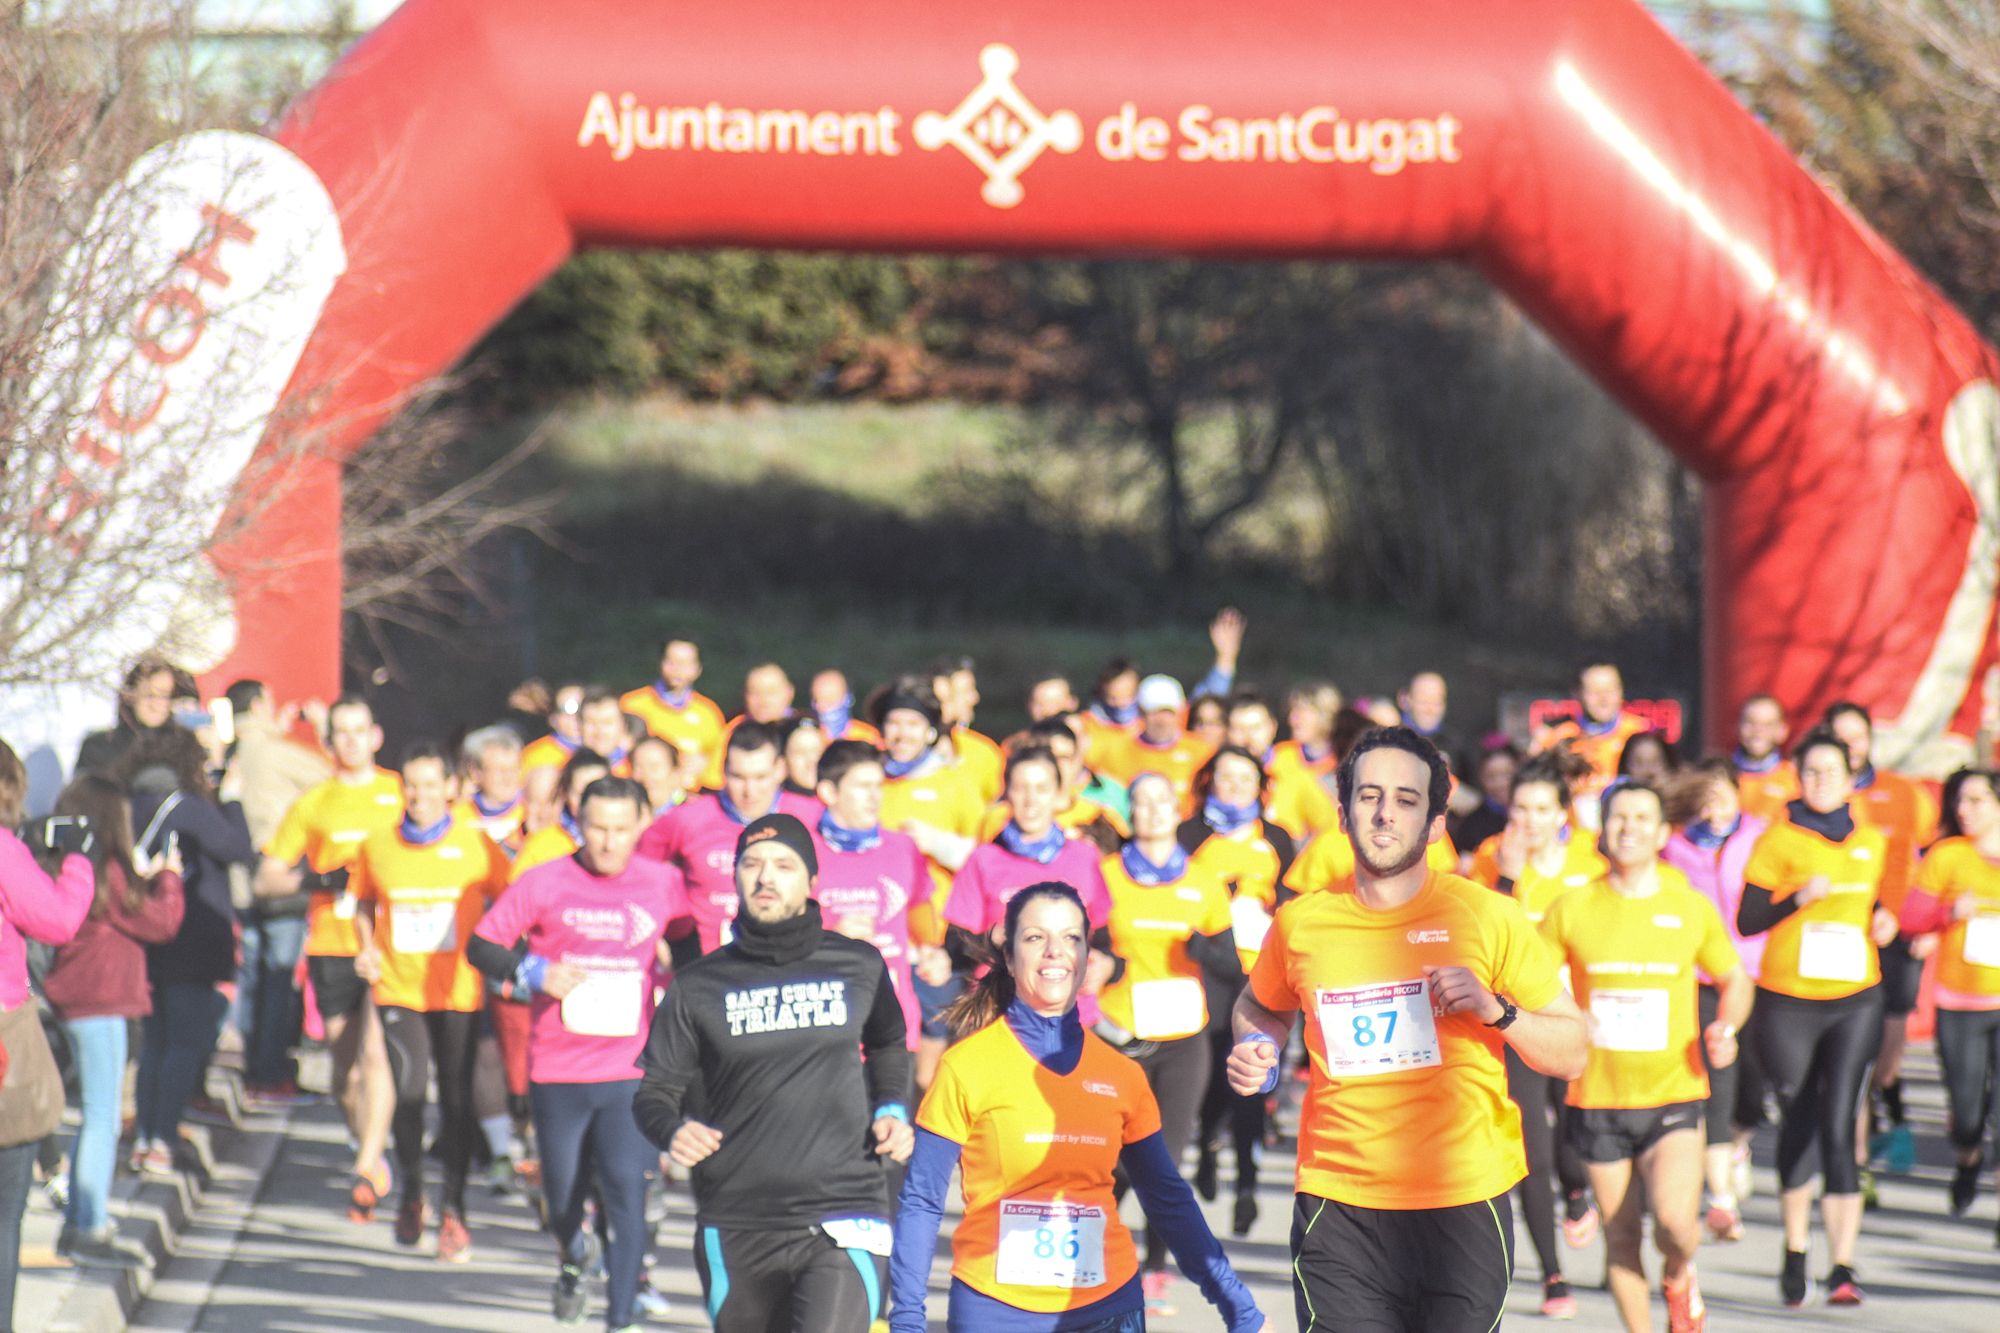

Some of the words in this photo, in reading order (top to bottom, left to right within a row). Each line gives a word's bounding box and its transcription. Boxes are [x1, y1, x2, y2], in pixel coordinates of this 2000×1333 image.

[578, 90, 902, 161] Ajuntament
[1096, 101, 1170, 161] de
[1178, 103, 1462, 175] SantCugat
[725, 986, 779, 1011] SANT
[781, 980, 845, 1004] CUGAT
[1332, 993, 1354, 1003] Cursa
[1393, 984, 1420, 996] RICOH
[726, 1000, 847, 1037] TRIATLO
[1352, 1010, 1398, 1047] 87
[1019, 1206, 1042, 1215] Cursa
[1034, 1227, 1080, 1261] 86
